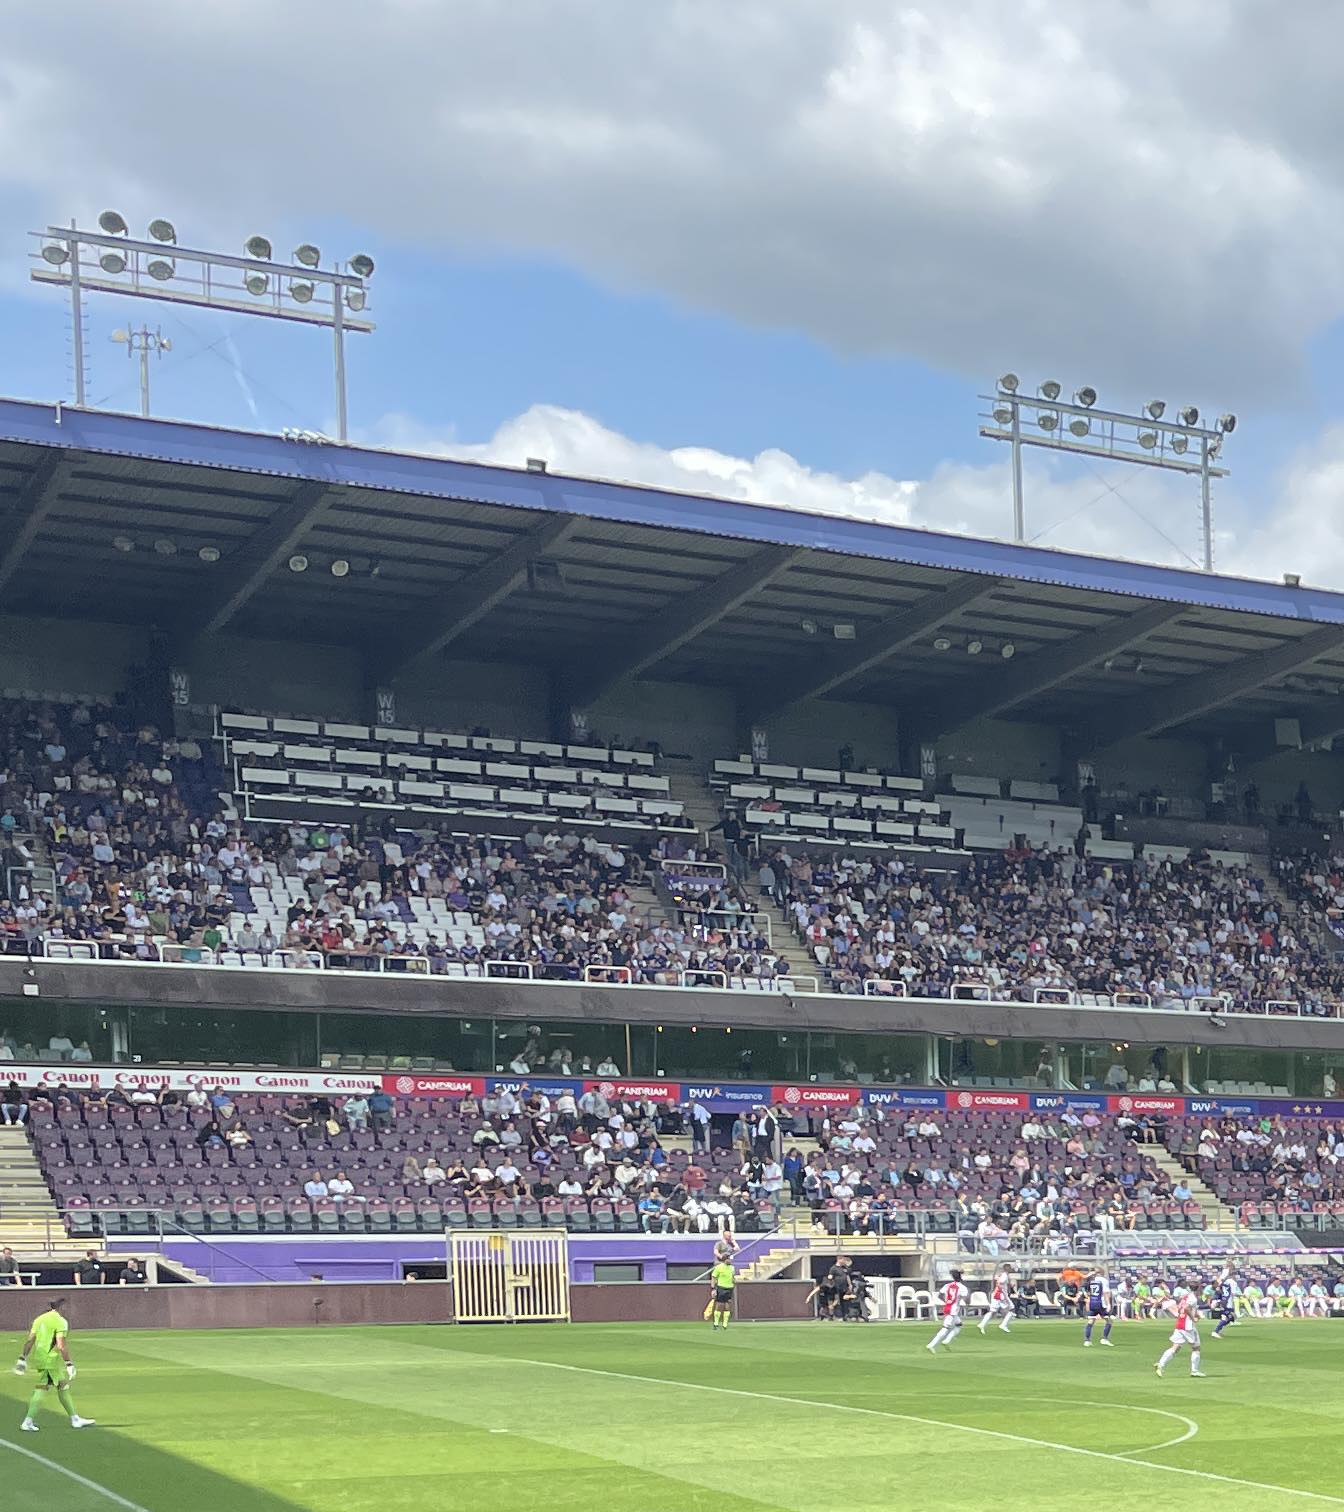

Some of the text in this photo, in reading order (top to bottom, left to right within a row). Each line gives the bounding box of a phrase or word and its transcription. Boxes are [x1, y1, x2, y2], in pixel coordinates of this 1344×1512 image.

[379, 692, 393, 708] W
[380, 709, 394, 723] 15
[43, 1071, 100, 1083] Canon
[115, 1072, 171, 1085] Canon
[186, 1073, 241, 1086] Canon
[255, 1075, 309, 1087] Canon
[323, 1077, 376, 1089] Canon
[417, 1081, 472, 1091] CANDRIAM
[617, 1085, 668, 1096] CANDRIAM
[689, 1088, 713, 1098] DVV
[803, 1091, 849, 1100] CANDRIAM
[869, 1093, 891, 1103] DVV
[975, 1095, 1019, 1105] CANDRIAM
[1036, 1097, 1057, 1107] DVV
[1134, 1100, 1175, 1109] CANDRIAM
[1191, 1102, 1211, 1111] DVV
